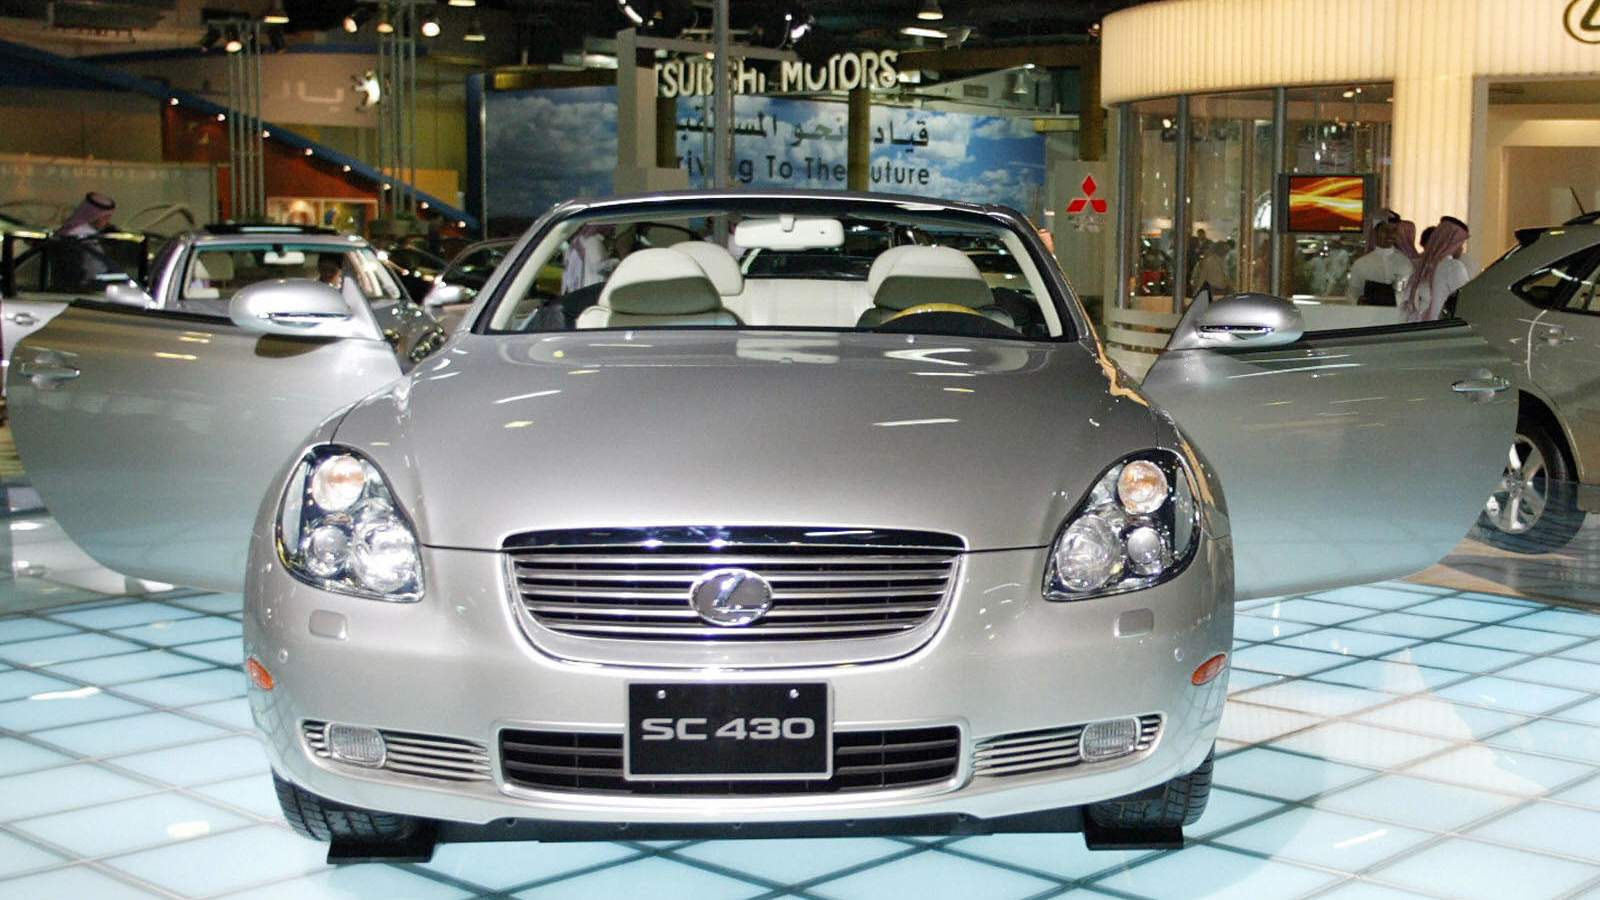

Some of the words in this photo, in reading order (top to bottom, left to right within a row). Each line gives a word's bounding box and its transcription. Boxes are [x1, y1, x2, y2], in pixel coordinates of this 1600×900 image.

[782, 50, 898, 92] MOTORS
[873, 120, 929, 153] قياد
[766, 155, 793, 179] To
[804, 156, 846, 181] The
[871, 161, 930, 185] uture
[641, 717, 708, 741] SC
[714, 717, 816, 741] 430
